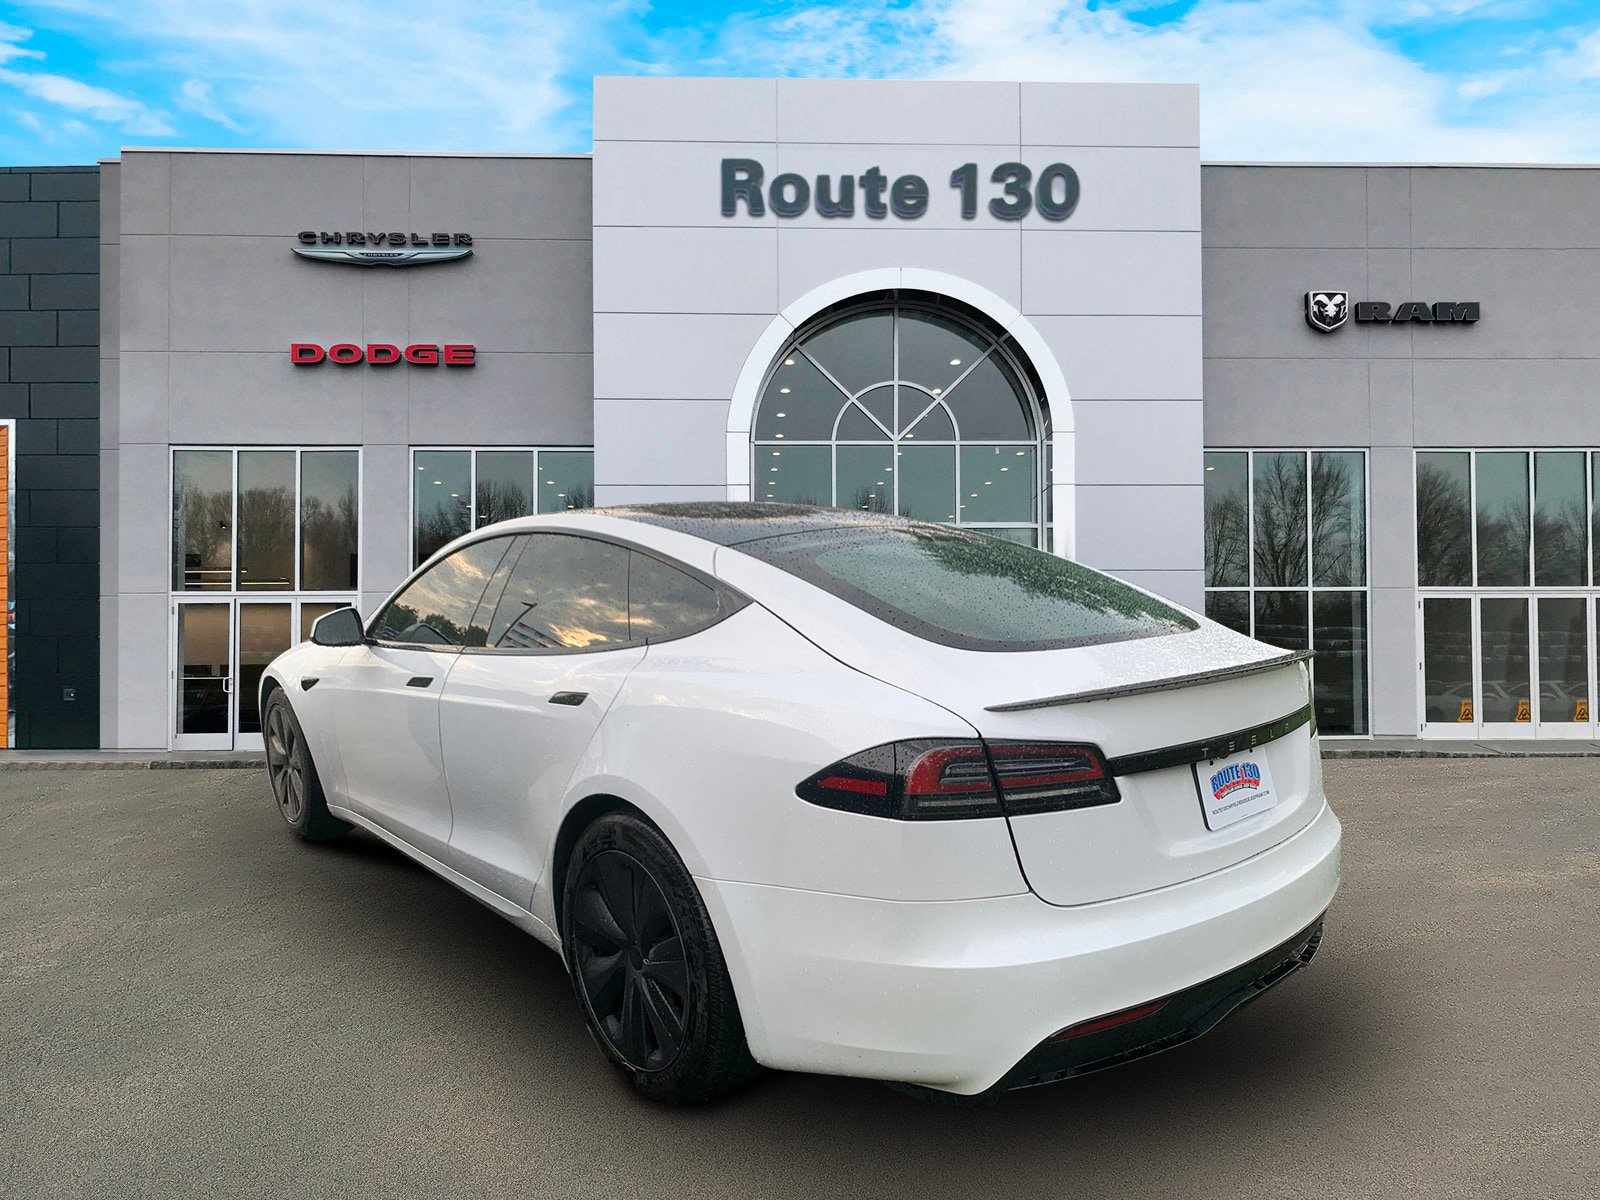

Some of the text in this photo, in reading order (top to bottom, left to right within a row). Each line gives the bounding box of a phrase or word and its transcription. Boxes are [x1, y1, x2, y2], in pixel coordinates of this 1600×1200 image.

[721, 158, 1080, 222] Route 130
[298, 231, 473, 245] CHRYSLER
[1355, 302, 1480, 323] RAM
[291, 343, 475, 365] DODGE
[1210, 763, 1241, 793] ROUTE
[1241, 762, 1261, 780] 130
